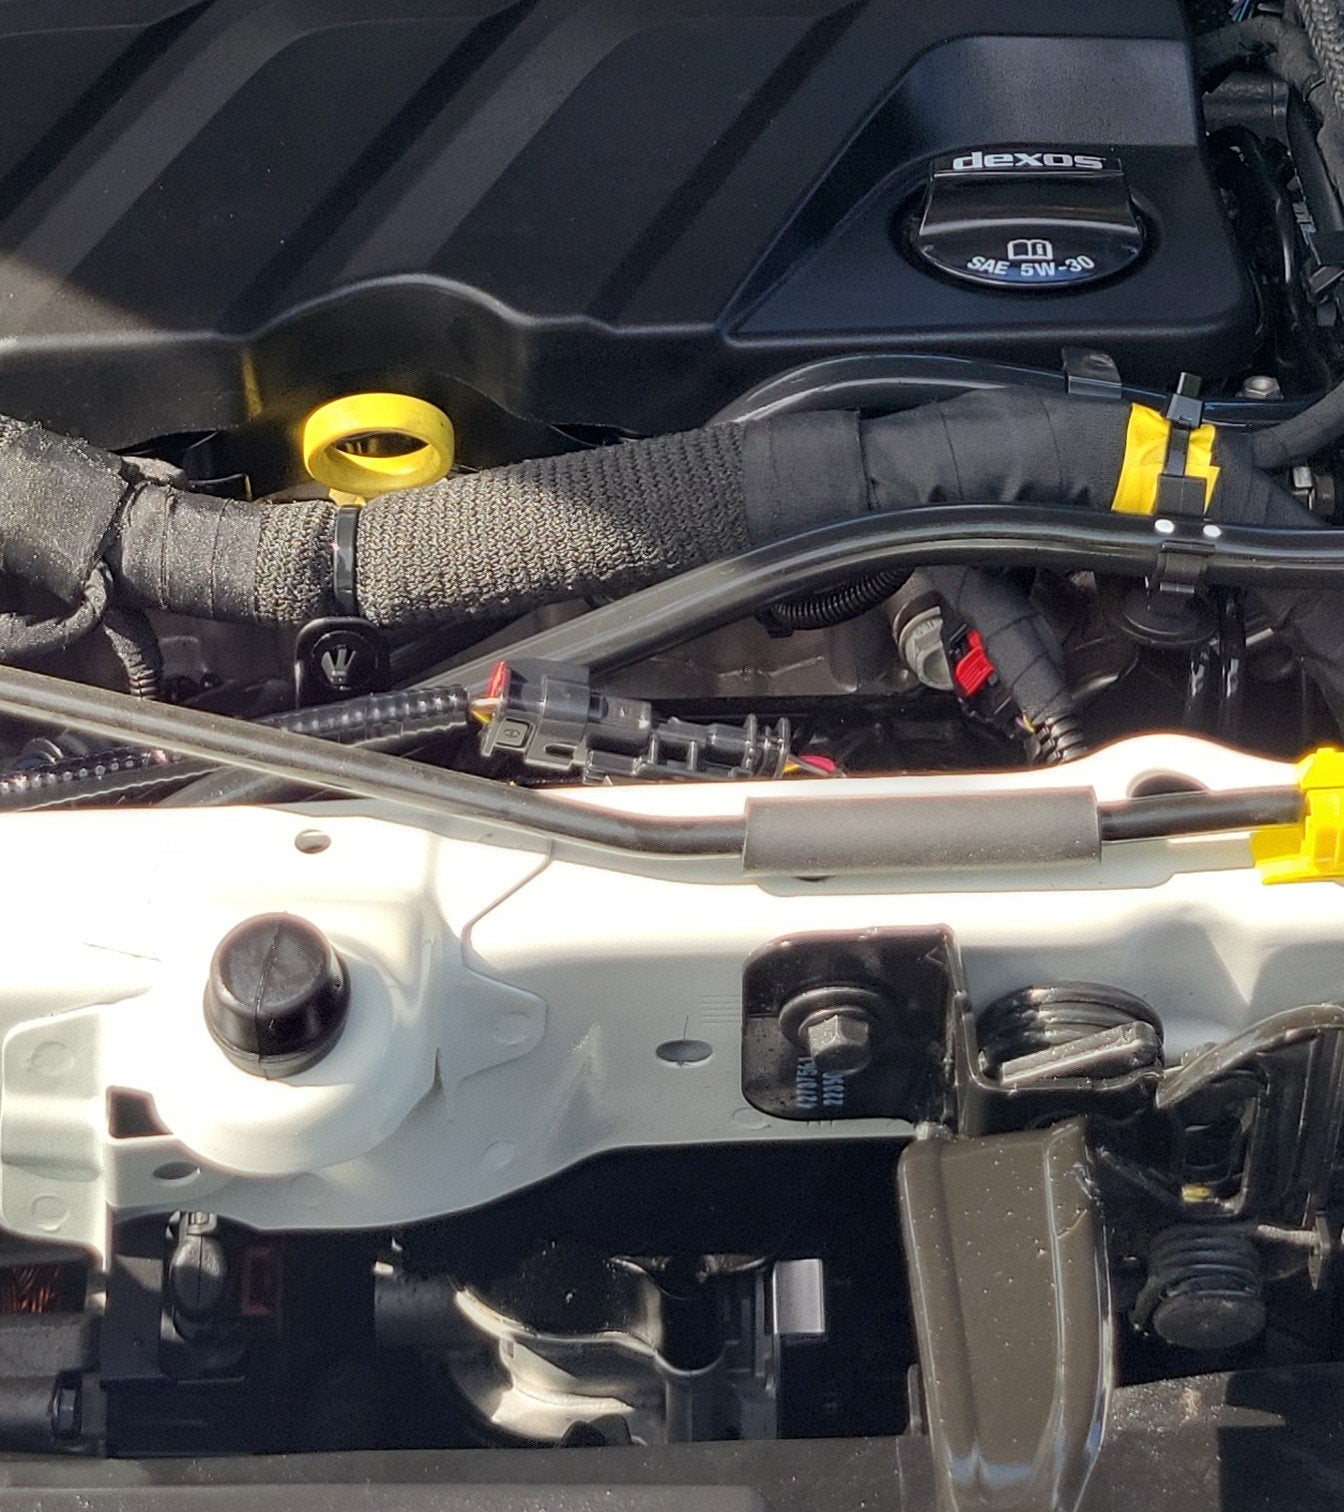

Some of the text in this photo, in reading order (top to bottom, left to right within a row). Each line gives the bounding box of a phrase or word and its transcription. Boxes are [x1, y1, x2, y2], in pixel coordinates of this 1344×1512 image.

[952, 151, 1104, 170] dexos
[967, 254, 1096, 277] SAE 5W-30
